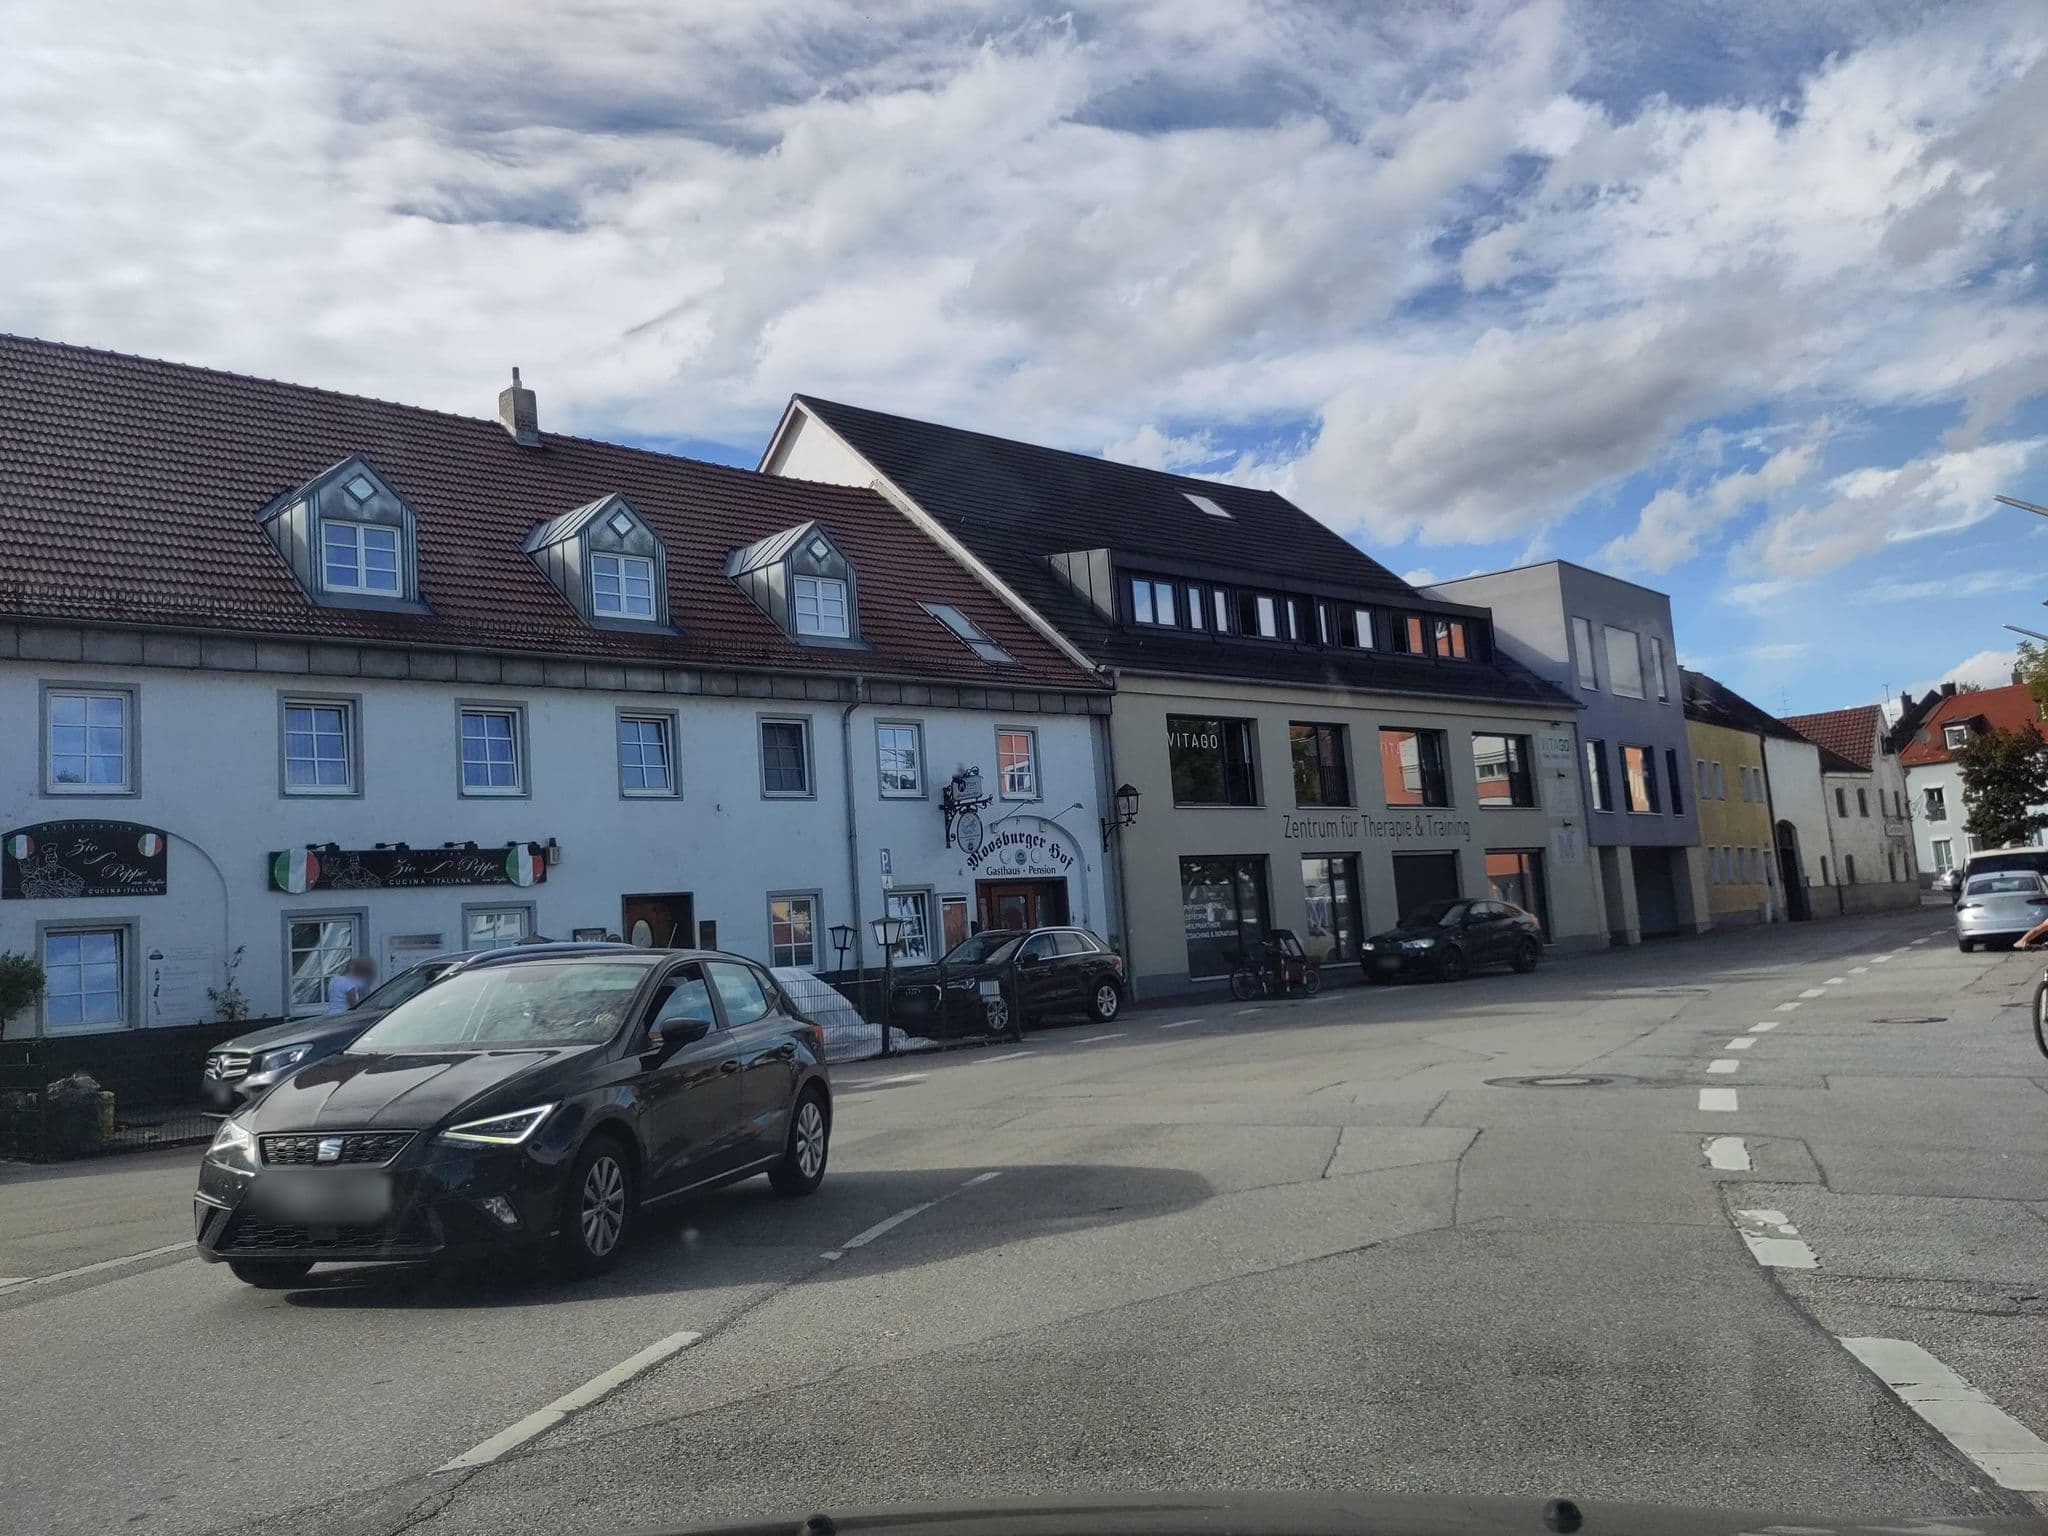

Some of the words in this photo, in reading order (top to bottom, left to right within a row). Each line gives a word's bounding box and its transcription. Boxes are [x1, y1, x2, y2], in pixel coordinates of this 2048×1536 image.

[1166, 732, 1218, 749] VITAGO
[1283, 814, 1338, 839] Zentrum
[1341, 814, 1358, 839] für
[1361, 814, 1411, 843] Therapie
[1415, 814, 1423, 837] &
[1426, 814, 1471, 842] Training
[881, 851, 889, 871] P
[967, 830, 1046, 871] Moosburger
[1049, 843, 1074, 872] Hof
[101, 863, 148, 883] Peppe
[457, 856, 499, 877] Peppe
[986, 865, 1021, 876] Gasthaus
[1029, 864, 1056, 875] Pension
[389, 878, 426, 886] CUCINA
[433, 877, 472, 885] ITALIANA
